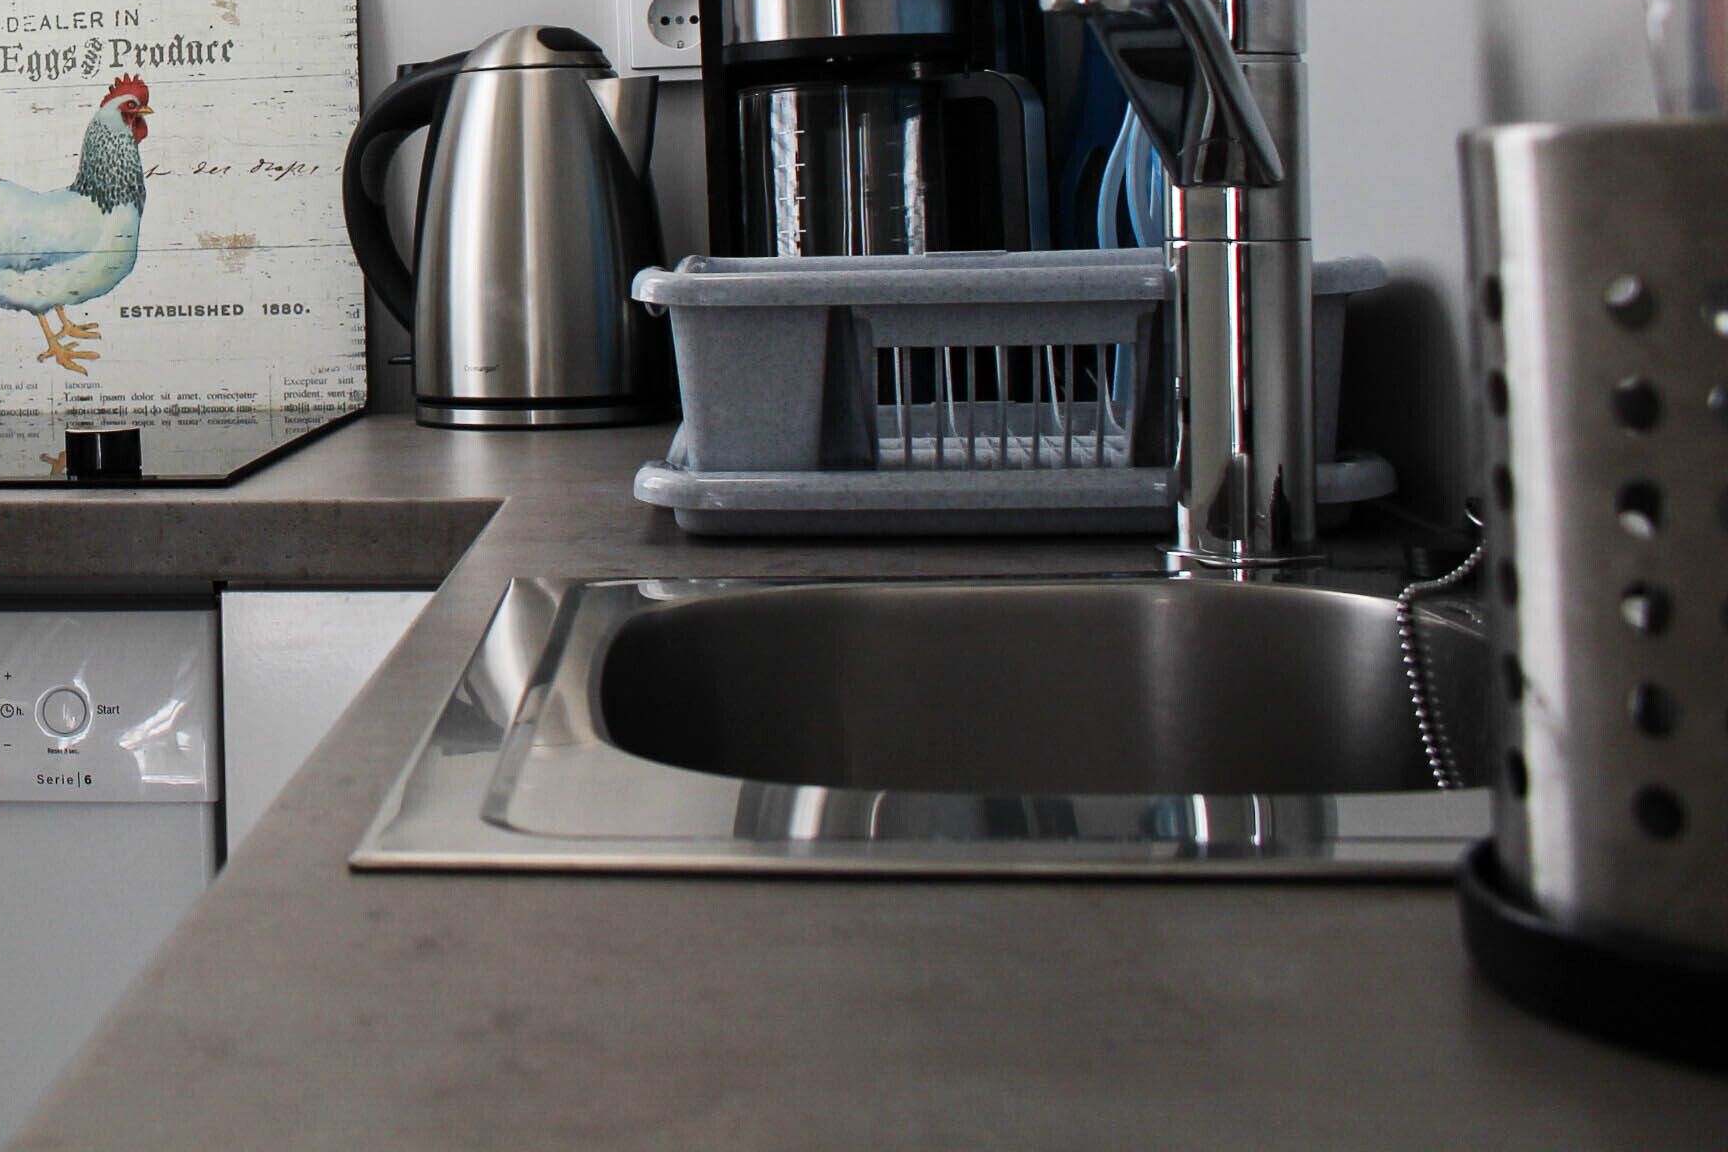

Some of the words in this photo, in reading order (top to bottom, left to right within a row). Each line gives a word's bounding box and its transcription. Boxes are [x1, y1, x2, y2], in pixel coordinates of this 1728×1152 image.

[7, 11, 103, 33] DEALER
[115, 9, 139, 26] IN
[108, 34, 234, 69] Produce
[120, 304, 244, 319] ESTABLISHED
[262, 303, 311, 316] 1880.
[131, 392, 154, 401] dolor
[160, 391, 170, 400] sit
[97, 704, 120, 715] Start
